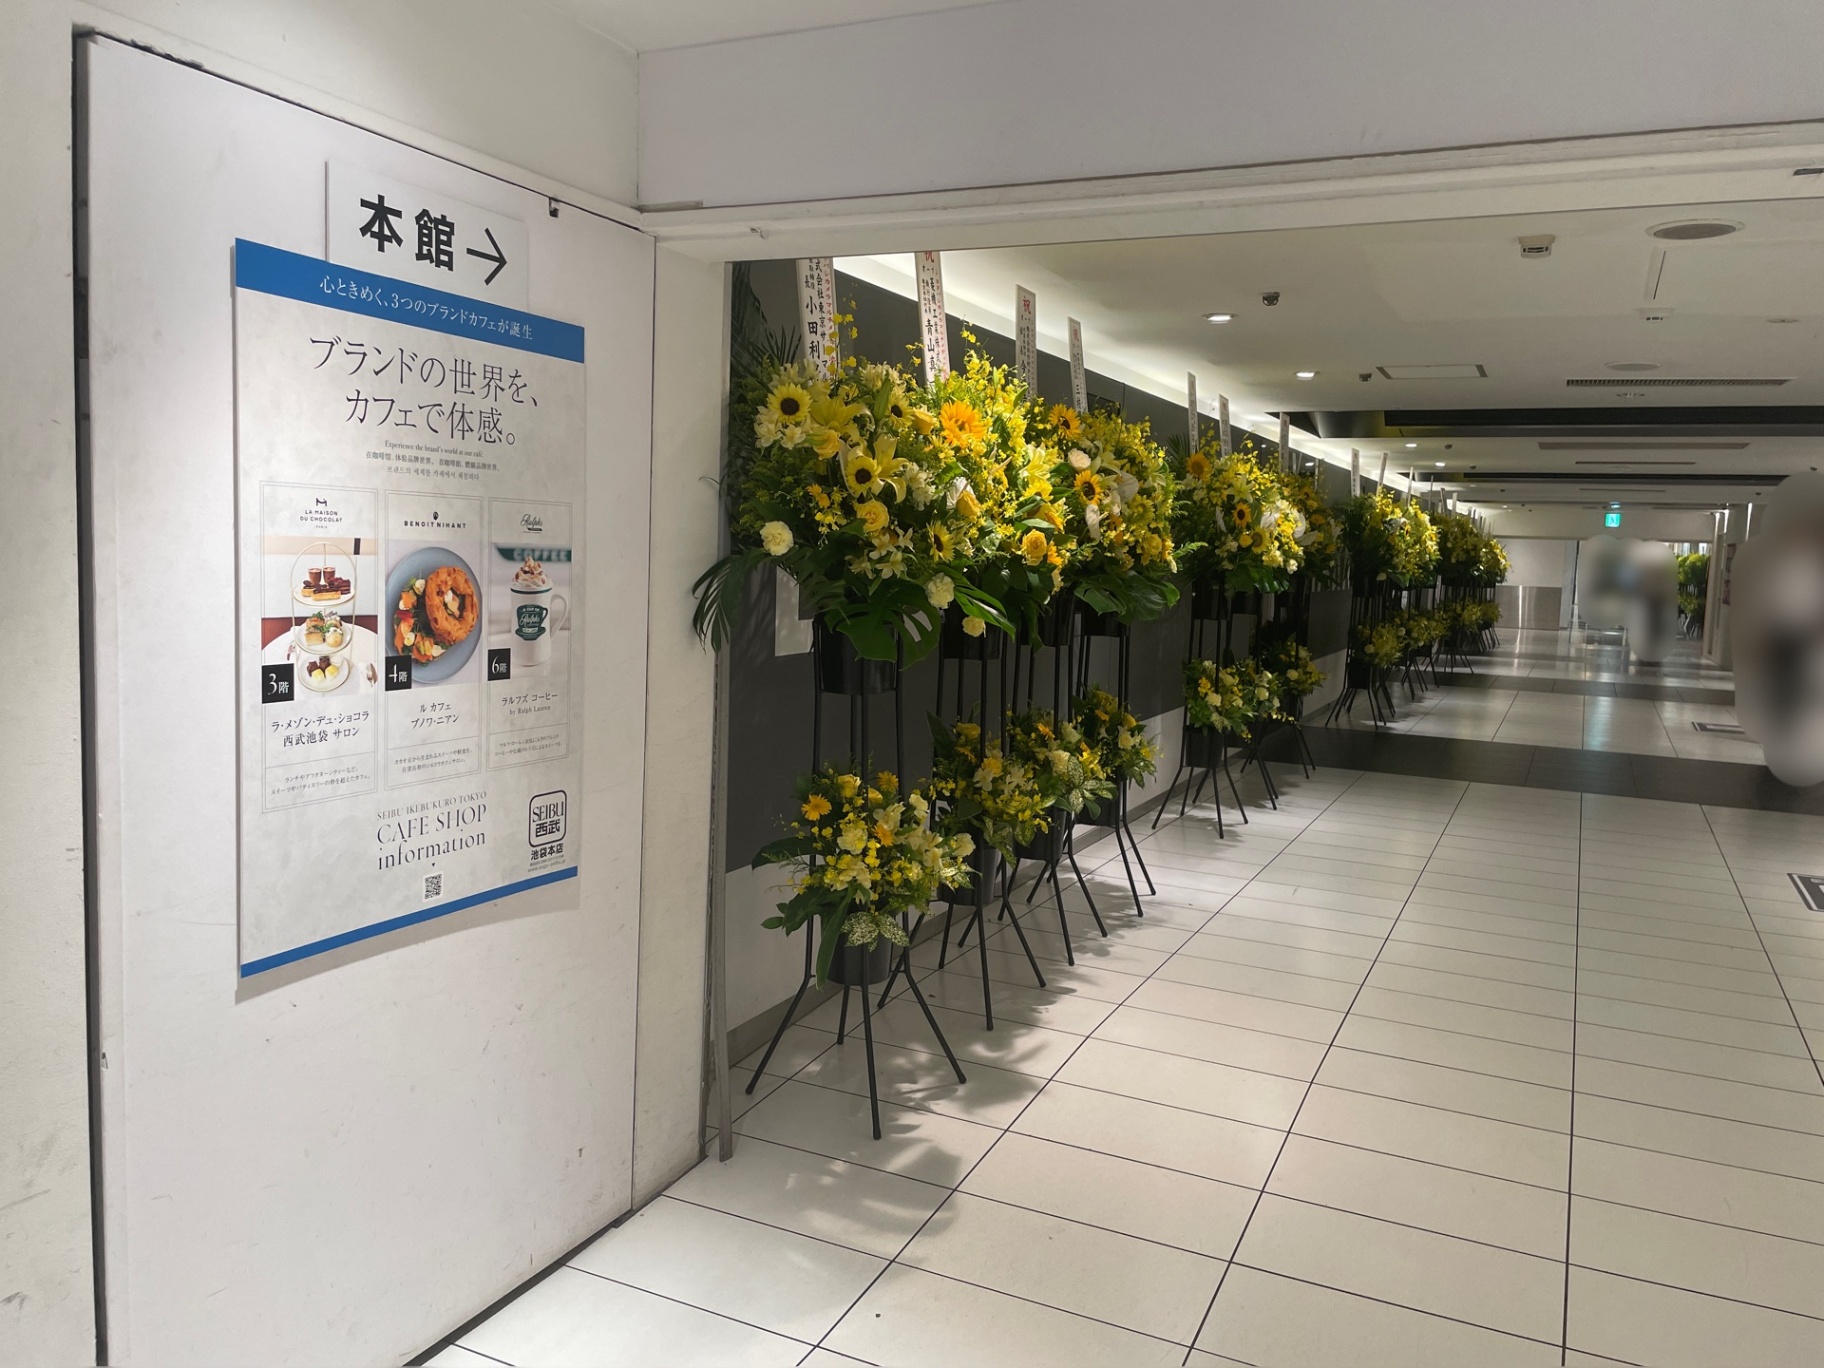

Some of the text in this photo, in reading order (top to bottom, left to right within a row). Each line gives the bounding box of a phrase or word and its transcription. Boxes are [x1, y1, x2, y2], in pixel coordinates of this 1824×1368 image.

[359, 194, 455, 272] 本館
[319, 275, 533, 340] 心ときめく、3つのブランドカフェが誕生
[310, 335, 539, 408] ブランドの世界を、
[345, 388, 516, 446] カフェで体感。
[385, 440, 414, 450] Experience
[444, 447, 458, 455] world
[404, 520, 434, 528] BENOIT
[388, 664, 408, 684] 4階
[491, 655, 508, 675] 6階
[269, 673, 289, 695] 3階
[430, 702, 452, 712] カフェ
[501, 692, 558, 706] ラルフズ コーヒー
[517, 706, 532, 715] Ralph
[283, 727, 360, 748] 西武池袋 サロン
[377, 790, 488, 820] SEIBU IKEBUKURO TOKYO
[532, 801, 564, 823] SEIBU
[377, 803, 488, 845] CAFE SHOP
[535, 819, 561, 838] 西武
[378, 828, 487, 870] information
[531, 843, 564, 860] 池袋本店
